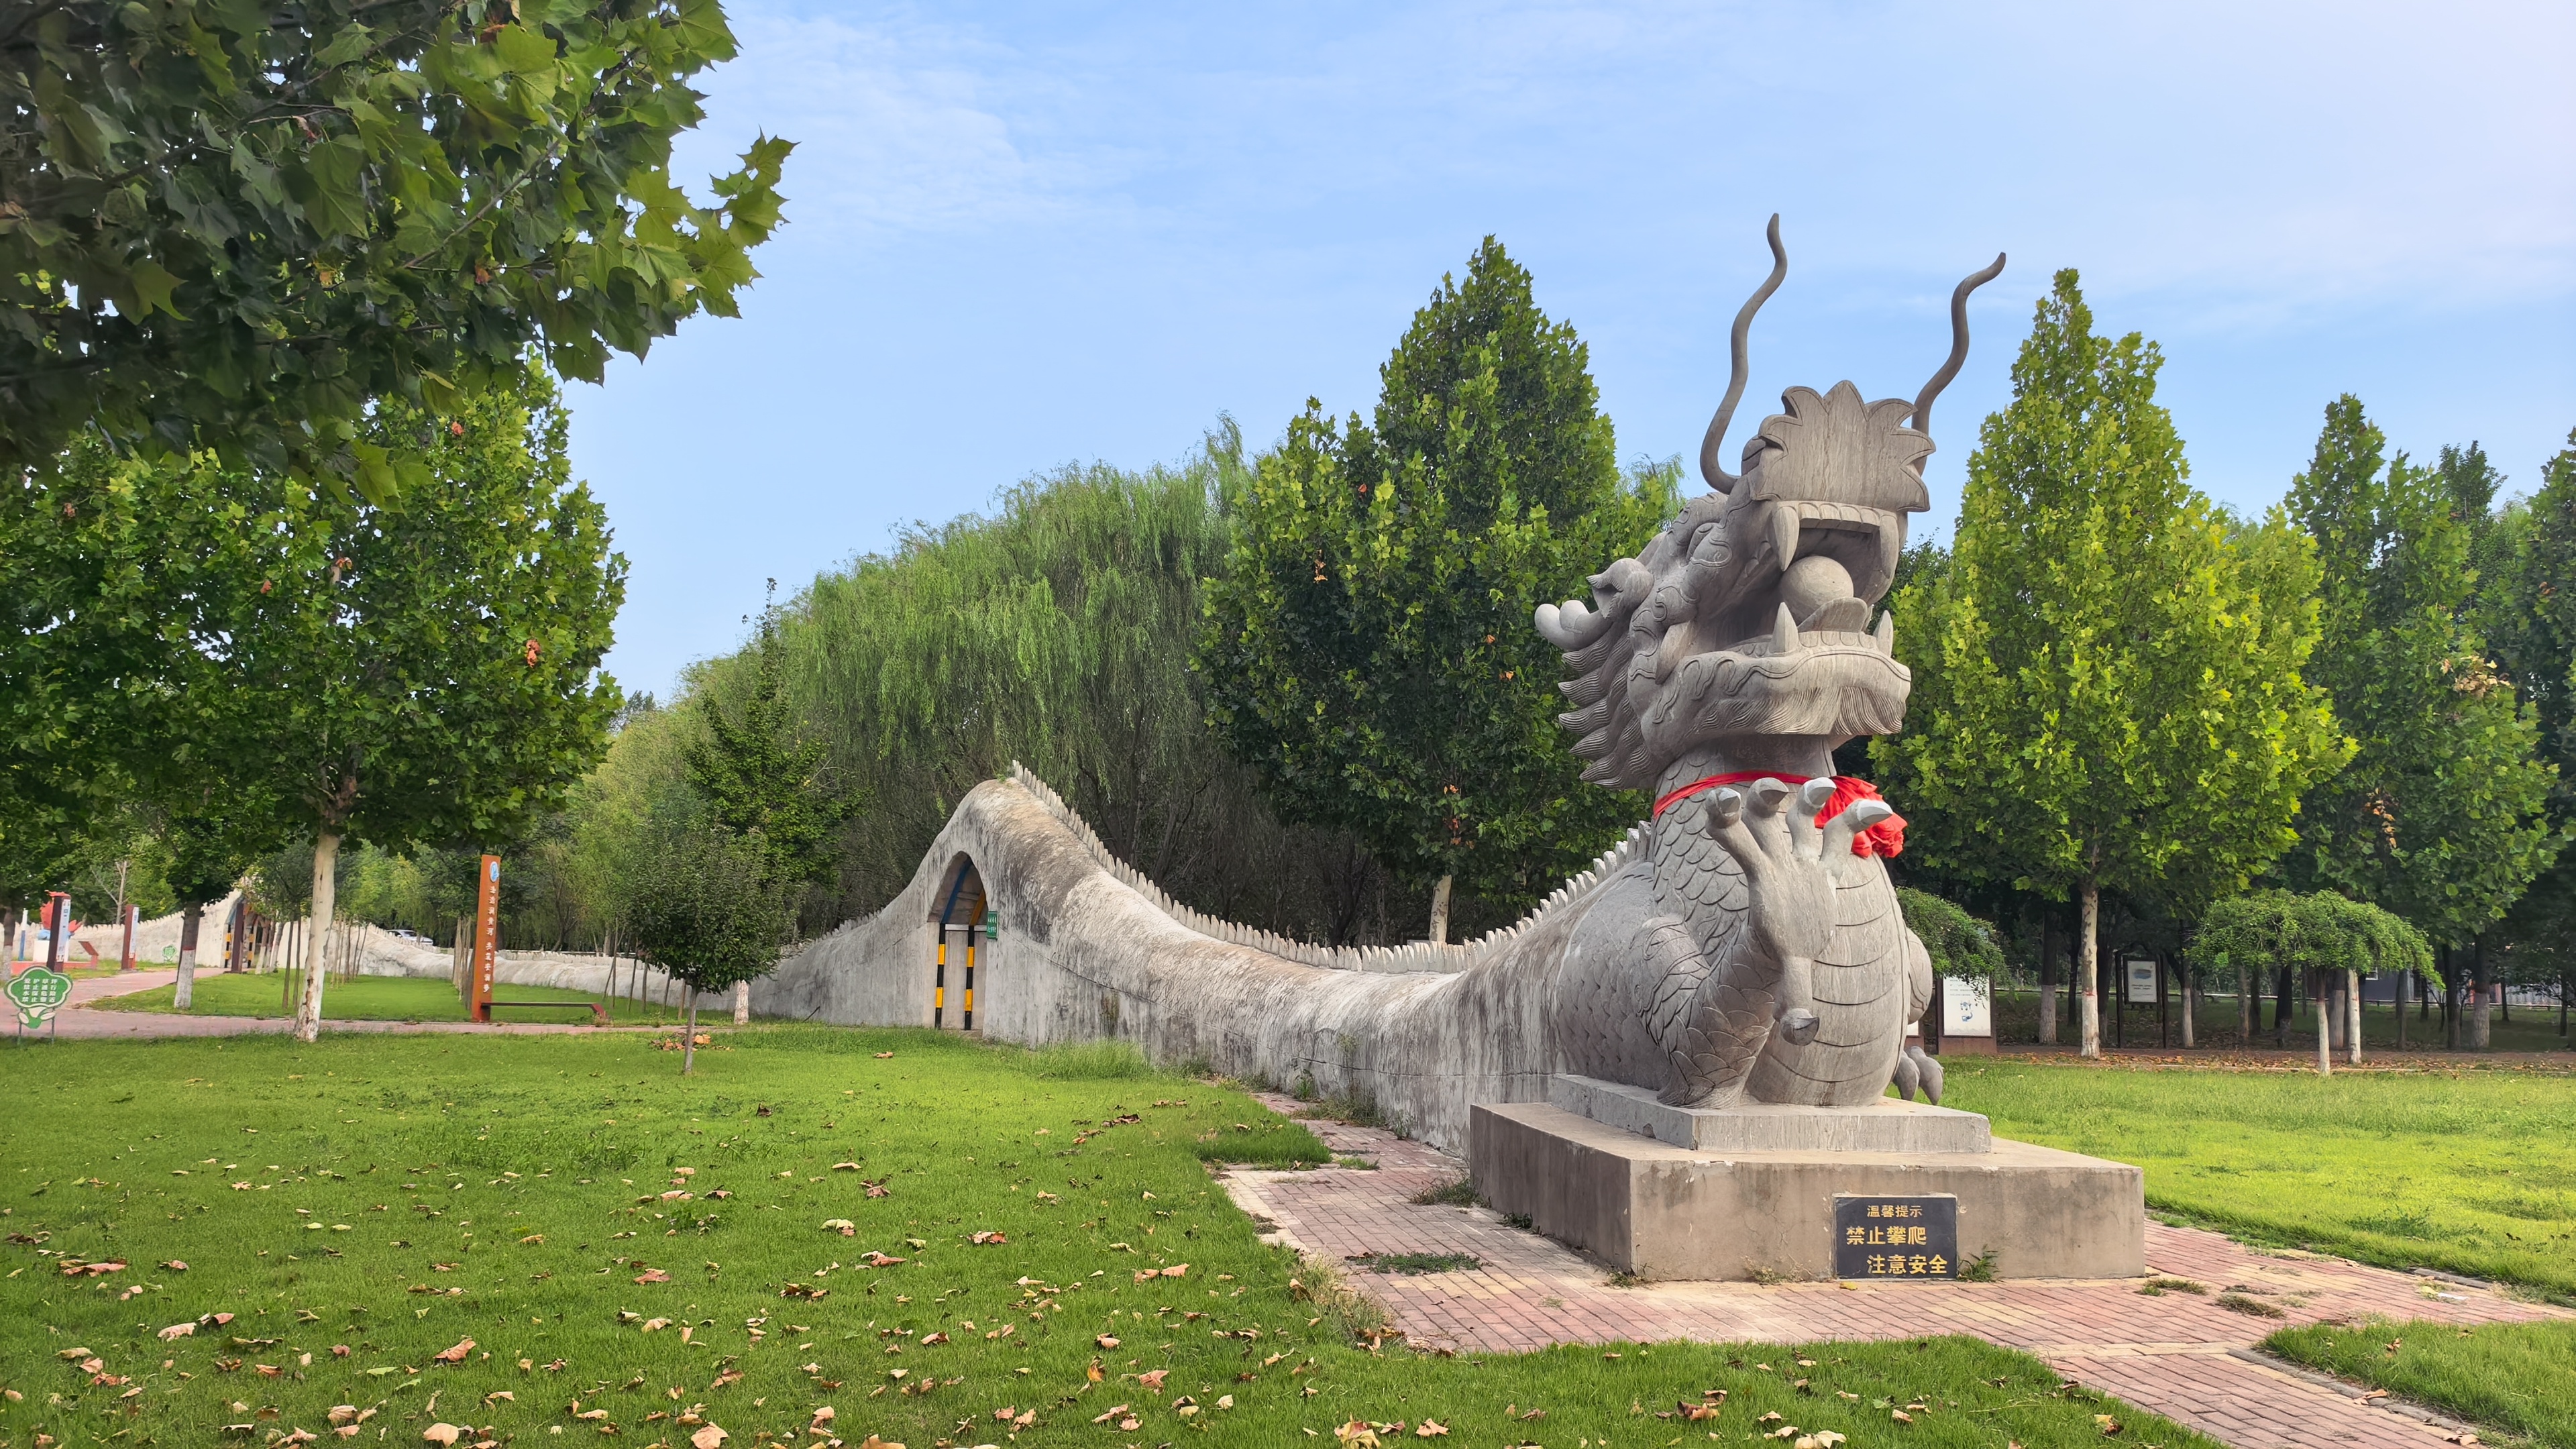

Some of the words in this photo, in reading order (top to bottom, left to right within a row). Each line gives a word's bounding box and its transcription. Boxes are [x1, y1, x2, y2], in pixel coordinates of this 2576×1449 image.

[1867, 1205, 1923, 1218] 温馨提示
[1846, 1226, 1927, 1246] 禁止攀爬
[1866, 1254, 1948, 1275] 注意安全
